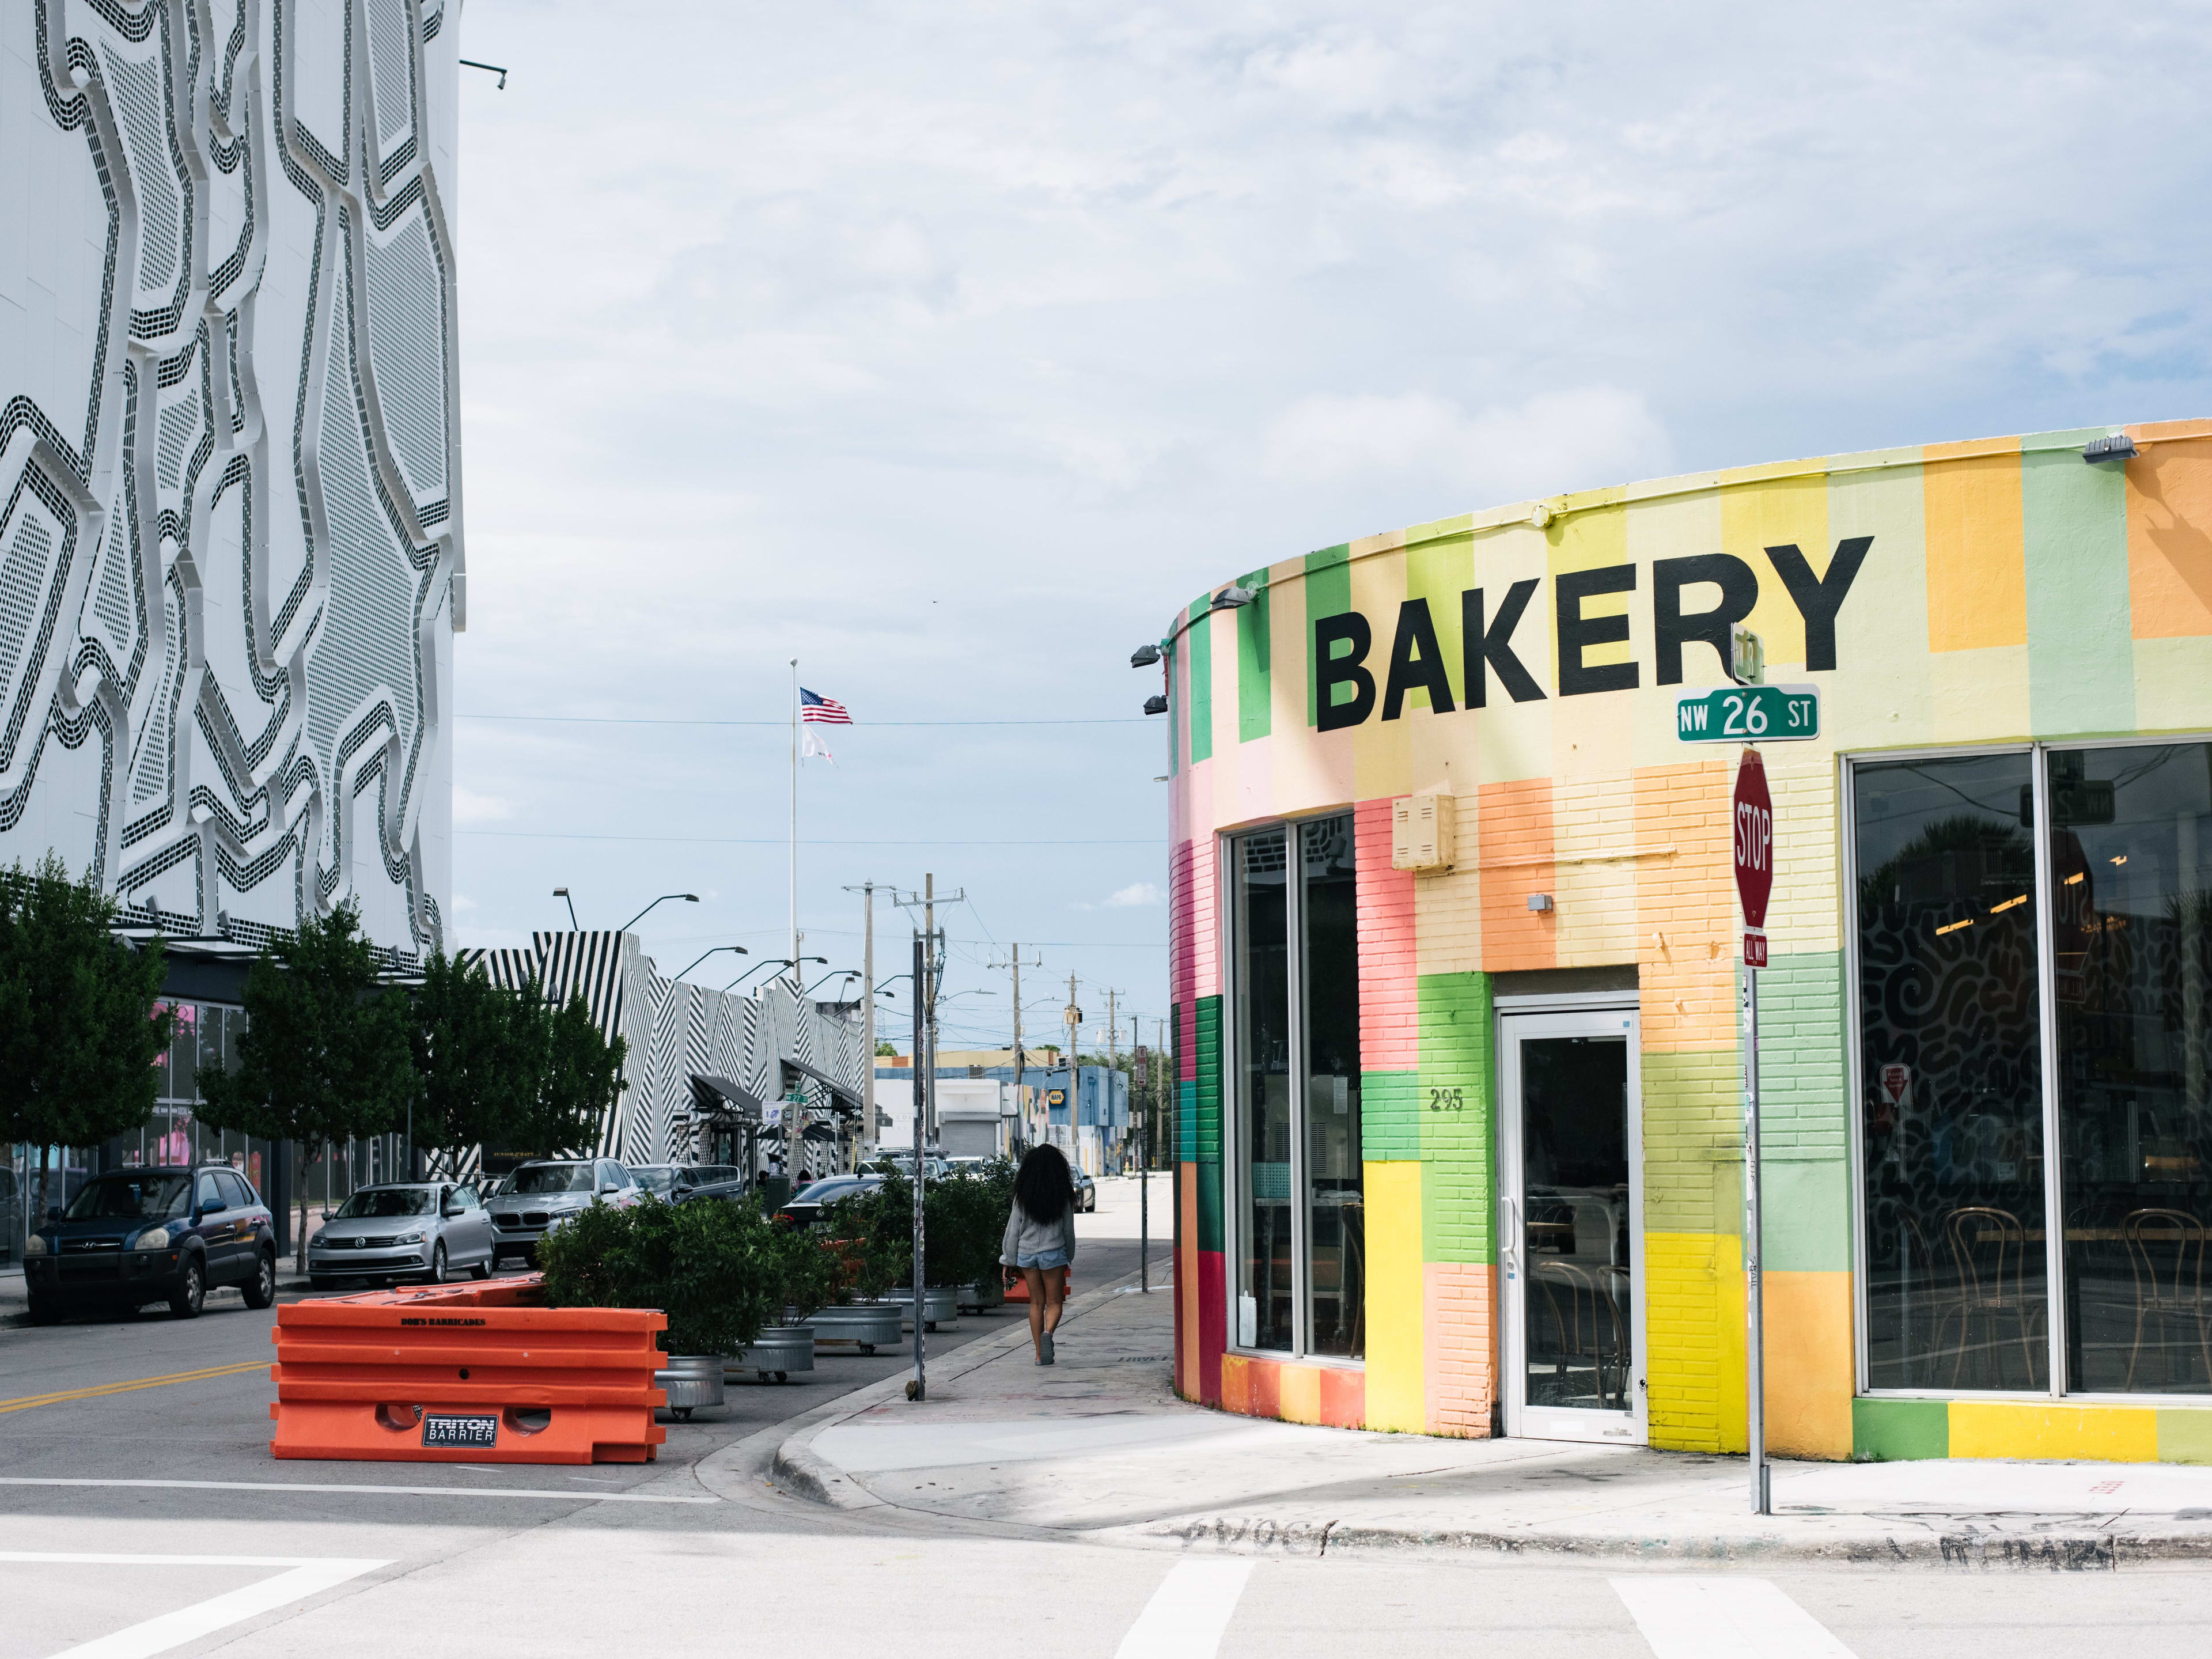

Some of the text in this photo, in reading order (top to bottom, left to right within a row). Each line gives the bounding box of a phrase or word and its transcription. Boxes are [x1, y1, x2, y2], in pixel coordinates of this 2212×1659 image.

[1315, 536, 1874, 733] BAKERY
[1680, 695, 1811, 735] NW 26 ST
[1737, 801, 1770, 871] STOP
[1745, 940, 1766, 961] ALL WAY
[1430, 1088, 1463, 1109] 295
[427, 1419, 495, 1430] TRITON
[429, 1429, 493, 1441] BARRIER
